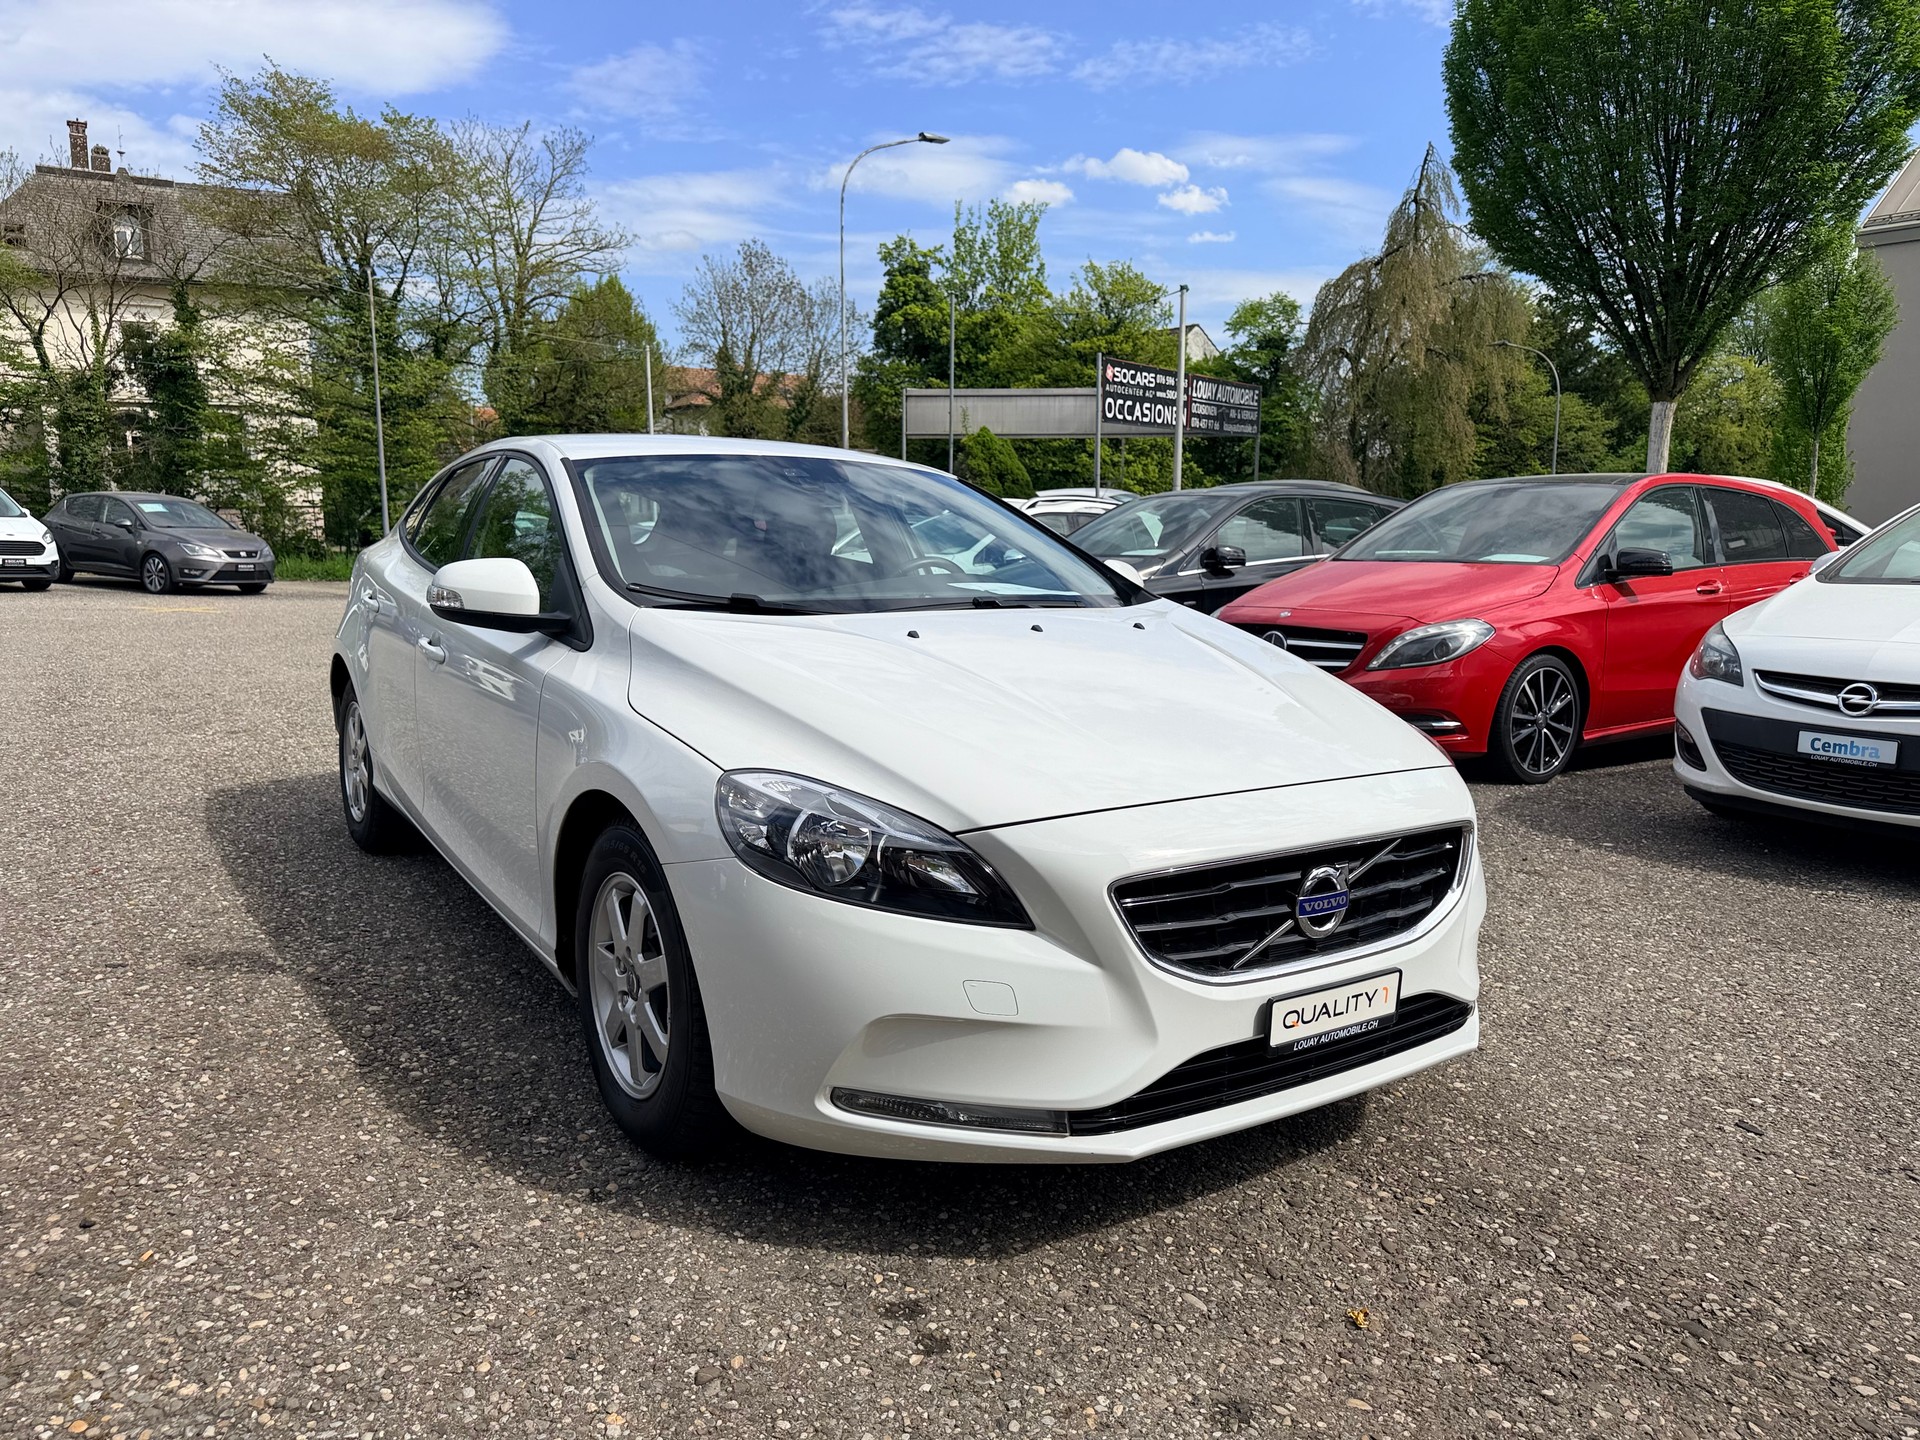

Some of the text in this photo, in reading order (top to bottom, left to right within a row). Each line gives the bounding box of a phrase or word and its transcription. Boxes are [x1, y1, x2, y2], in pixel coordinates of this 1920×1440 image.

[1113, 366, 1155, 388] SOCARS
[1105, 383, 1144, 397] AUTOCENTER
[1192, 379, 1218, 401] LOUAY
[1216, 384, 1259, 406] AUTOMOBILE
[1810, 737, 1880, 759] Cembra
[1829, 756, 1878, 767] AUTOMOBILE.CH
[1303, 895, 1347, 912] VOLVO
[1282, 986, 1389, 1029] QUALITY 1
[1293, 1019, 1379, 1051] LOUAY AUTOMOBILE.CH
